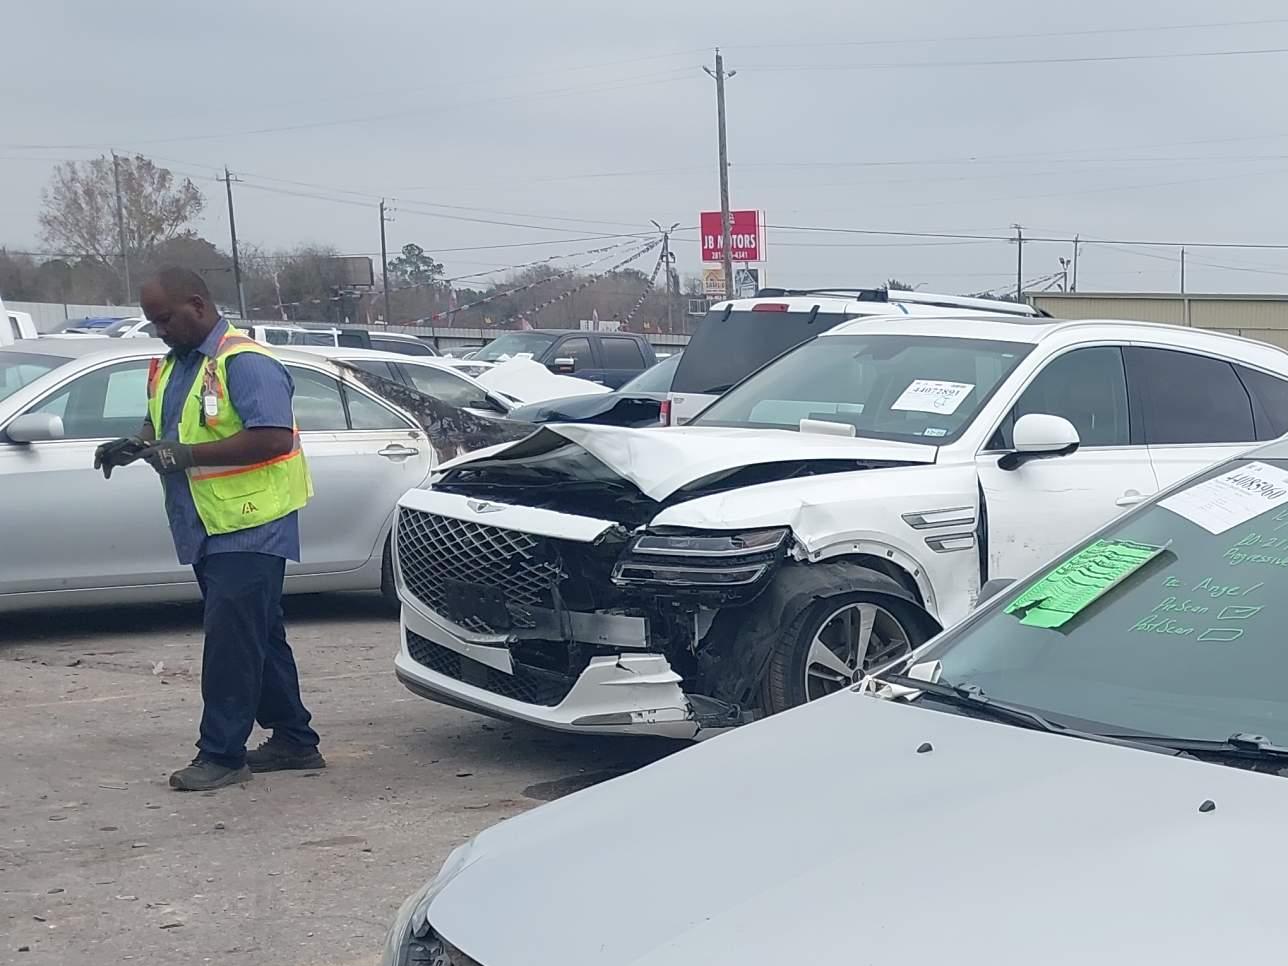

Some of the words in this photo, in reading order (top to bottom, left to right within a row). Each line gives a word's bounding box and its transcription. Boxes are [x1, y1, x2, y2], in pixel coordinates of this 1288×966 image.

[704, 235, 714, 249] JB
[717, 234, 756, 249] MTORS
[1225, 473, 1287, 500] 44085960
[1192, 577, 1265, 597] Angel
